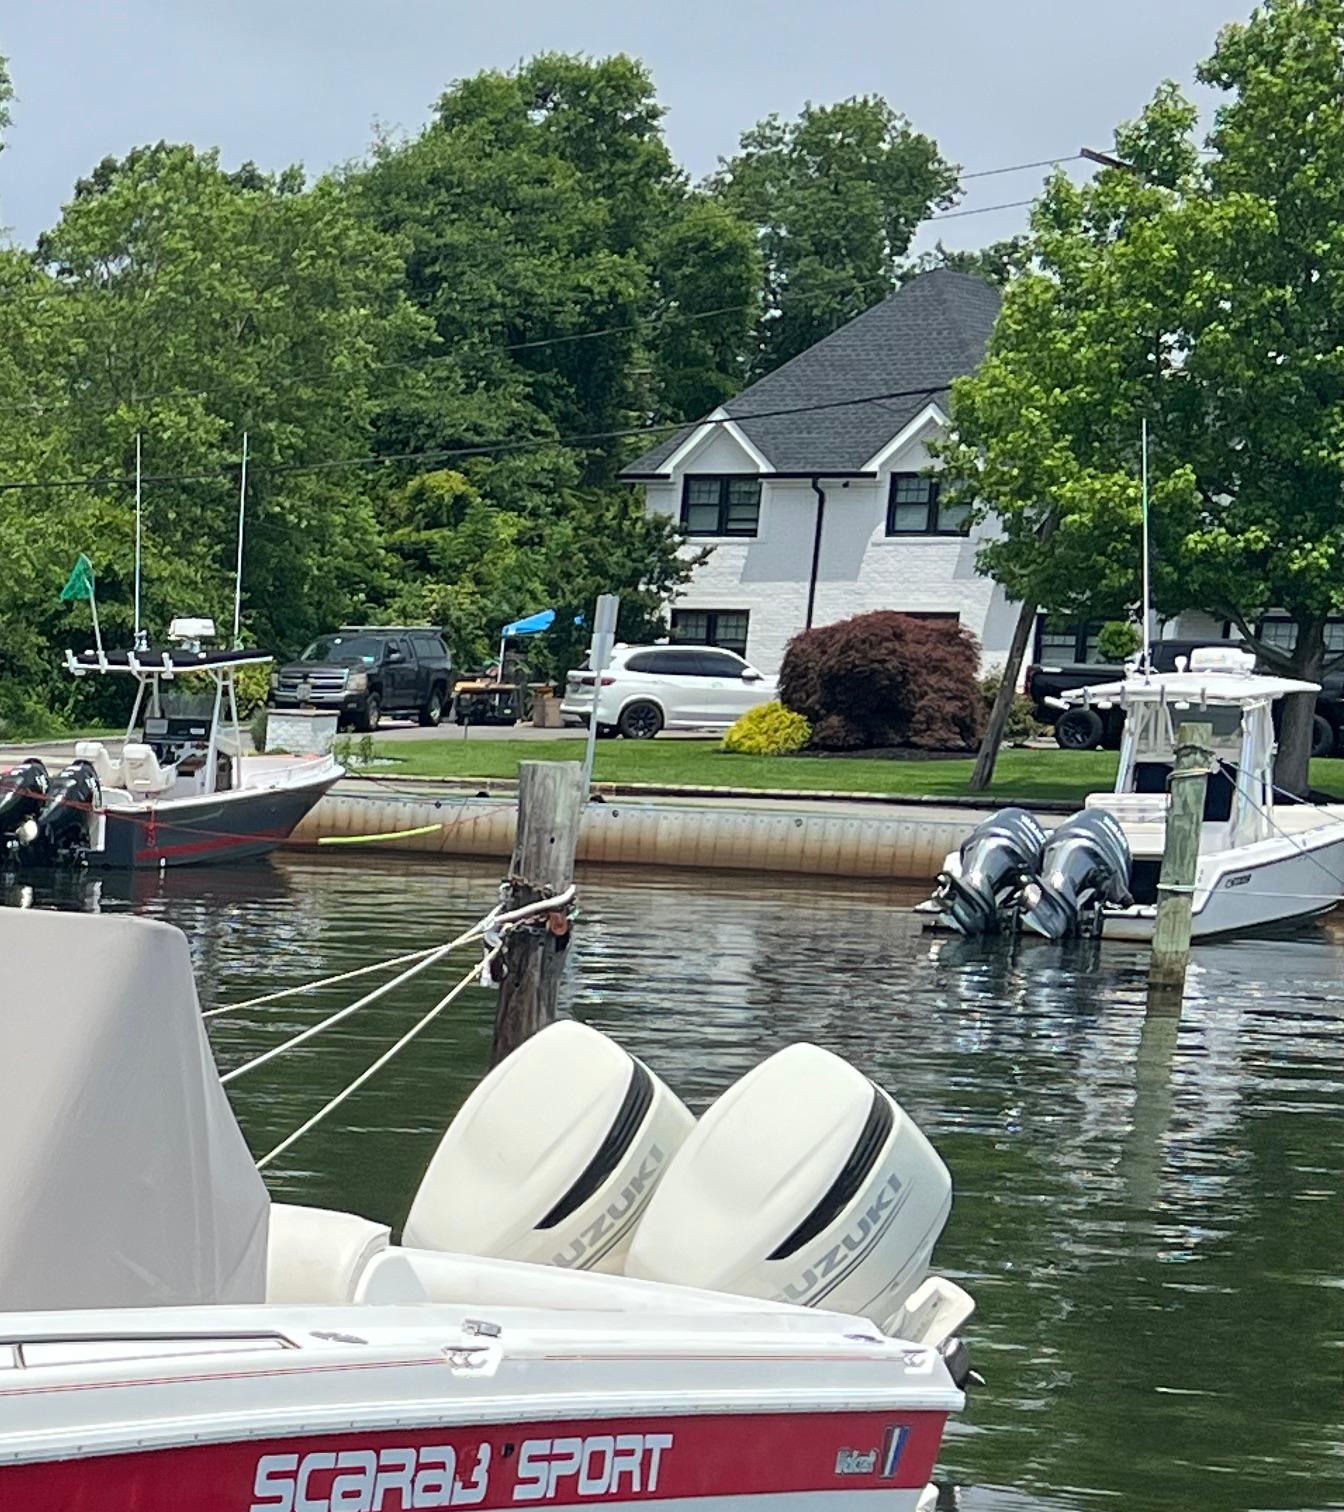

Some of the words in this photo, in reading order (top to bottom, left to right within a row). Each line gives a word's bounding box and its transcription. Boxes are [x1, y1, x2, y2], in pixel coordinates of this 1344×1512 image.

[552, 1143, 665, 1268] UZUKI
[779, 1173, 903, 1301] UZUKI
[513, 1434, 673, 1500] SPORT
